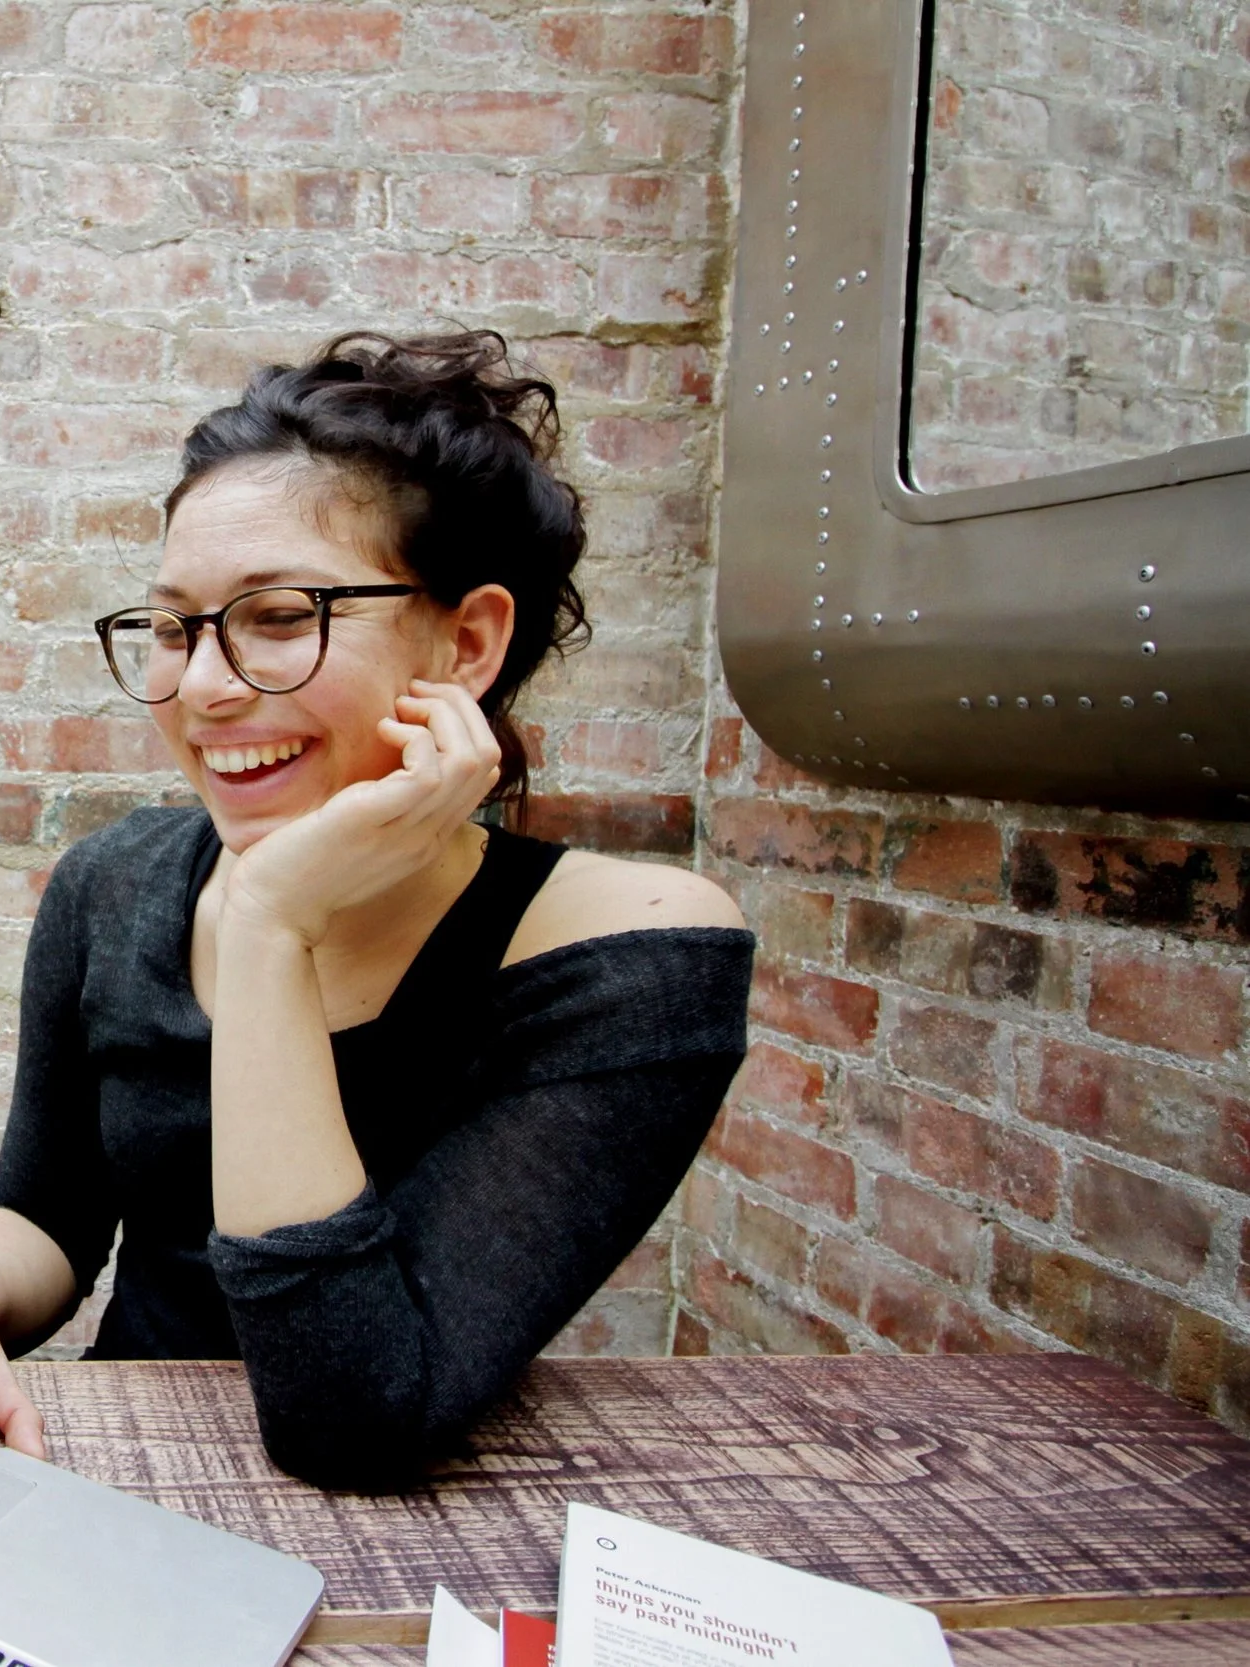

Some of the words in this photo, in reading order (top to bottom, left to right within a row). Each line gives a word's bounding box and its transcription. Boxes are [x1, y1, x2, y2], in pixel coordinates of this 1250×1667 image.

[595, 1566, 629, 1582] Peter
[634, 1579, 702, 1605] Ackerman
[595, 1578, 654, 1606] things
[660, 1600, 695, 1620] you
[703, 1613, 799, 1653] shouldn't
[595, 1594, 628, 1614] say
[635, 1606, 677, 1629] past
[684, 1622, 775, 1660] midnight
